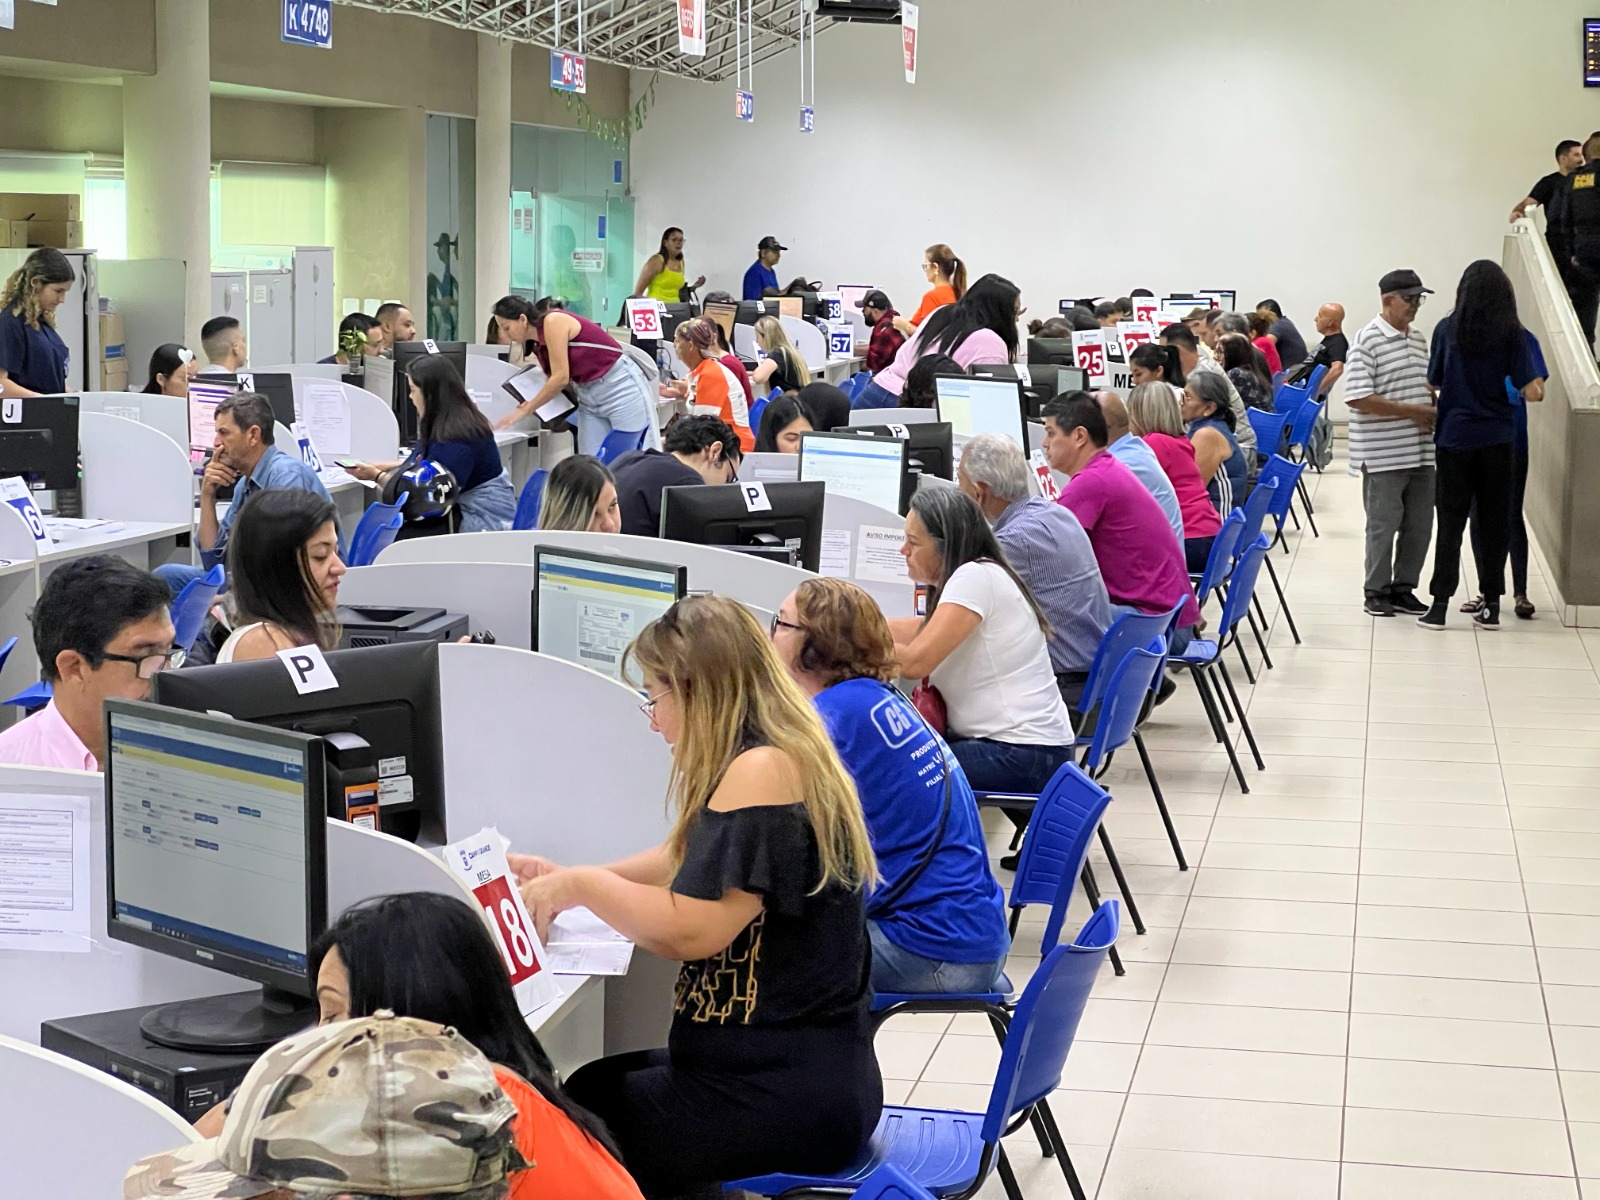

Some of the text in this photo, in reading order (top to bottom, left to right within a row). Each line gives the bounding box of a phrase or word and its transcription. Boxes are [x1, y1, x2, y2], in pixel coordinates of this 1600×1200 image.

[289, 3, 298, 31] K
[633, 313, 657, 331] 53
[831, 336, 851, 352] 57
[1110, 344, 1117, 353] P
[1079, 350, 1104, 375] 25
[240, 377, 251, 389] K
[5, 403, 15, 419] J
[893, 426, 903, 438] P
[1041, 472, 1062, 501] 23
[746, 487, 760, 505] P
[290, 655, 315, 684] P
[476, 868, 491, 883] MESA
[484, 897, 535, 976] 18
